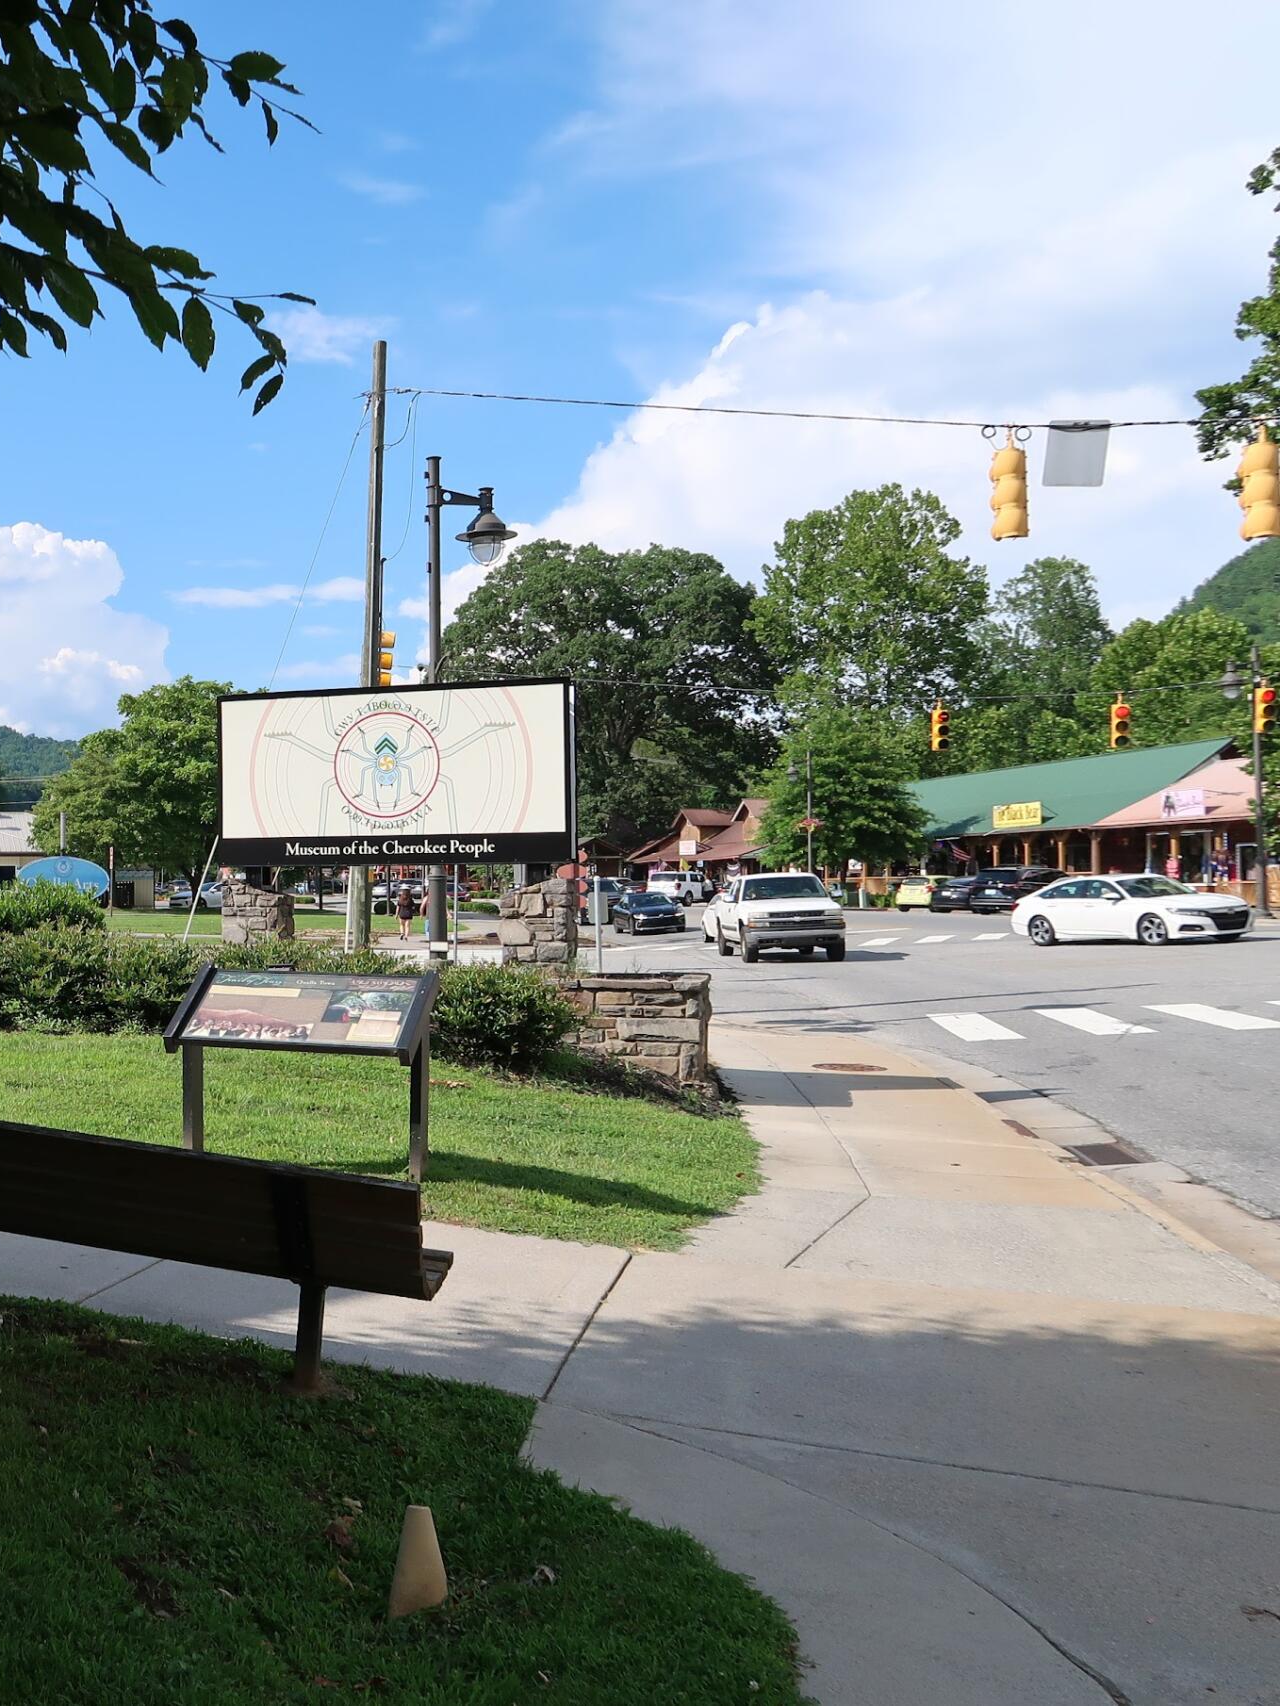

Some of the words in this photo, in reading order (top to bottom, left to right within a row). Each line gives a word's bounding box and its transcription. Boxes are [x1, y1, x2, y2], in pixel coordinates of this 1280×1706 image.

[285, 842, 340, 856] Museum
[342, 841, 360, 855] of
[359, 841, 380, 855] the
[382, 840, 447, 855] Cherokee
[449, 838, 496, 858] People
